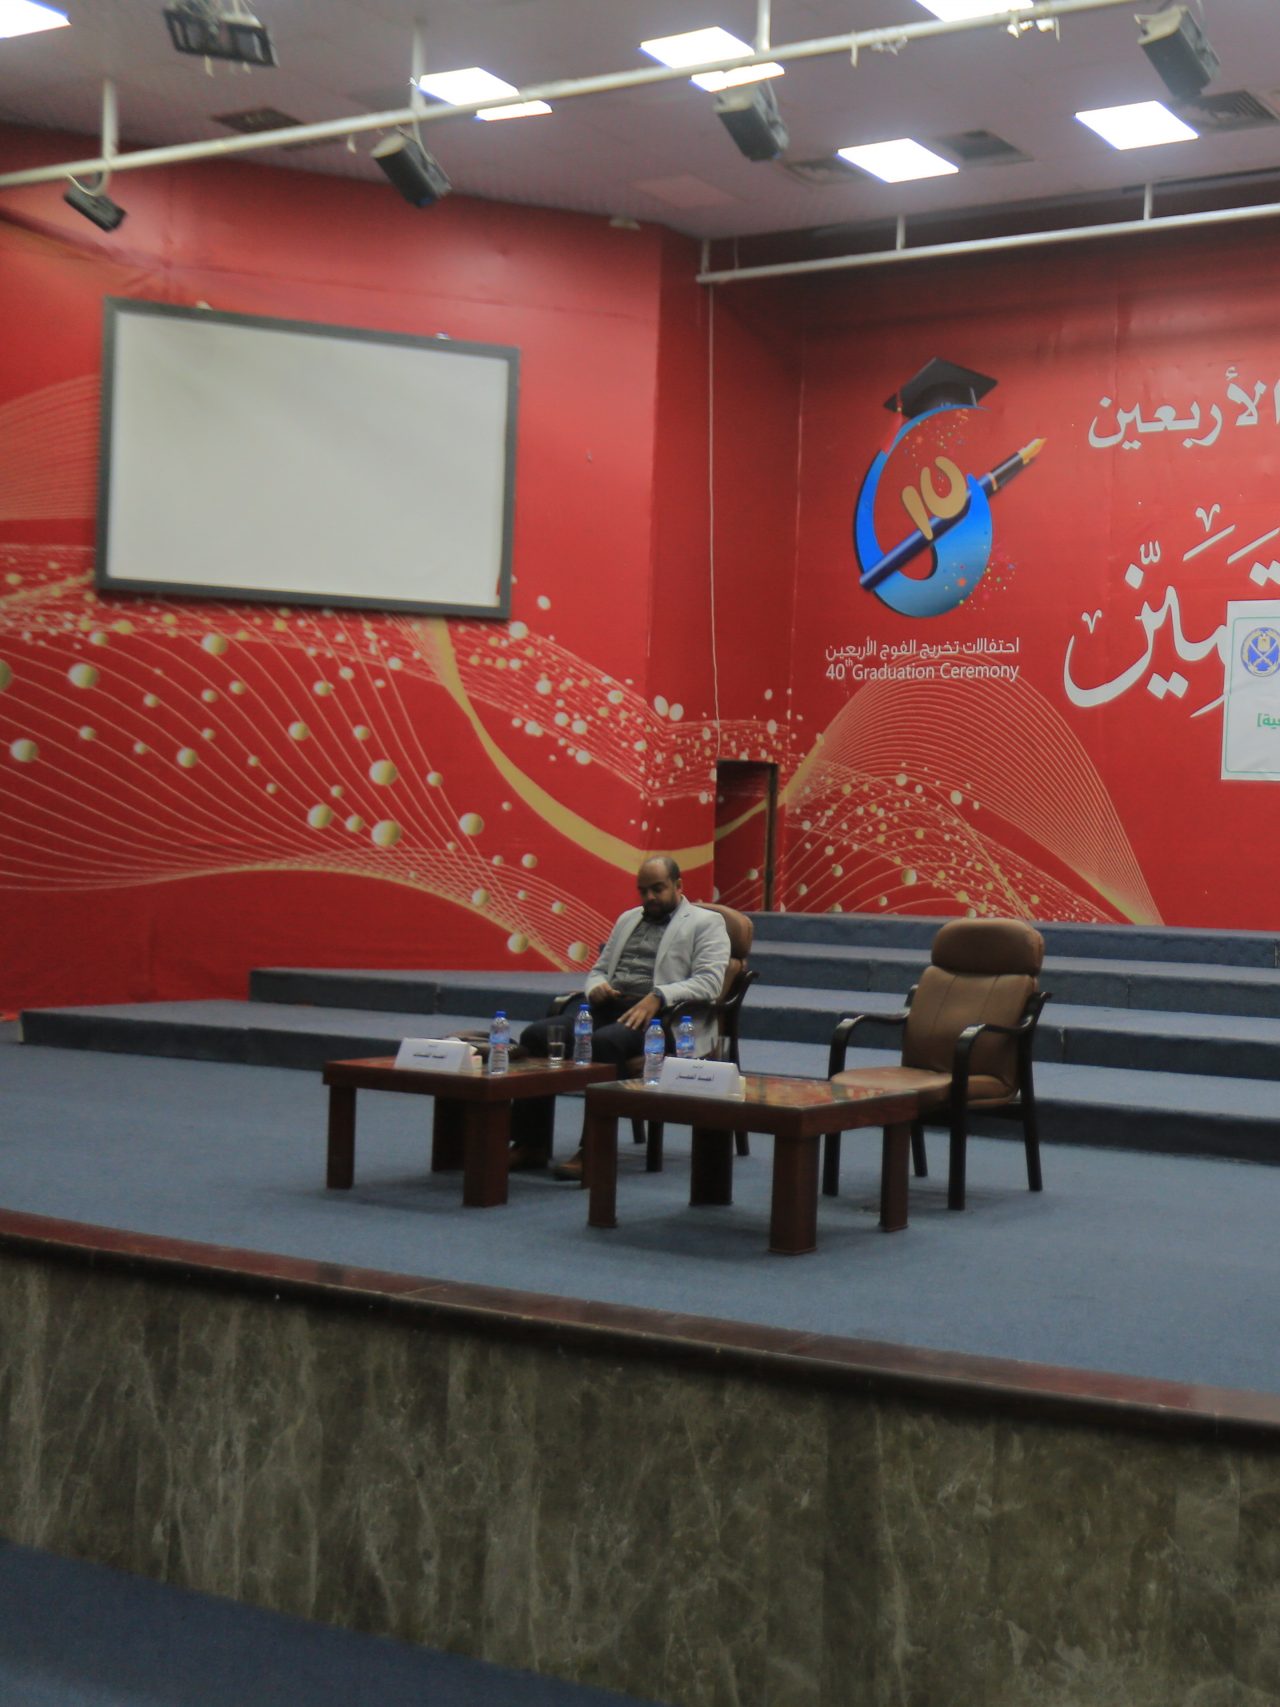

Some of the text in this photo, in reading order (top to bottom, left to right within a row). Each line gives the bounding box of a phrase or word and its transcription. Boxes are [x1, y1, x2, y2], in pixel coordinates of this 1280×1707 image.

[825, 636, 1020, 660] احتفالات تخريج الفوج الأربعين
[853, 663, 935, 681] Graduation
[940, 662, 1020, 682] Ceremony
